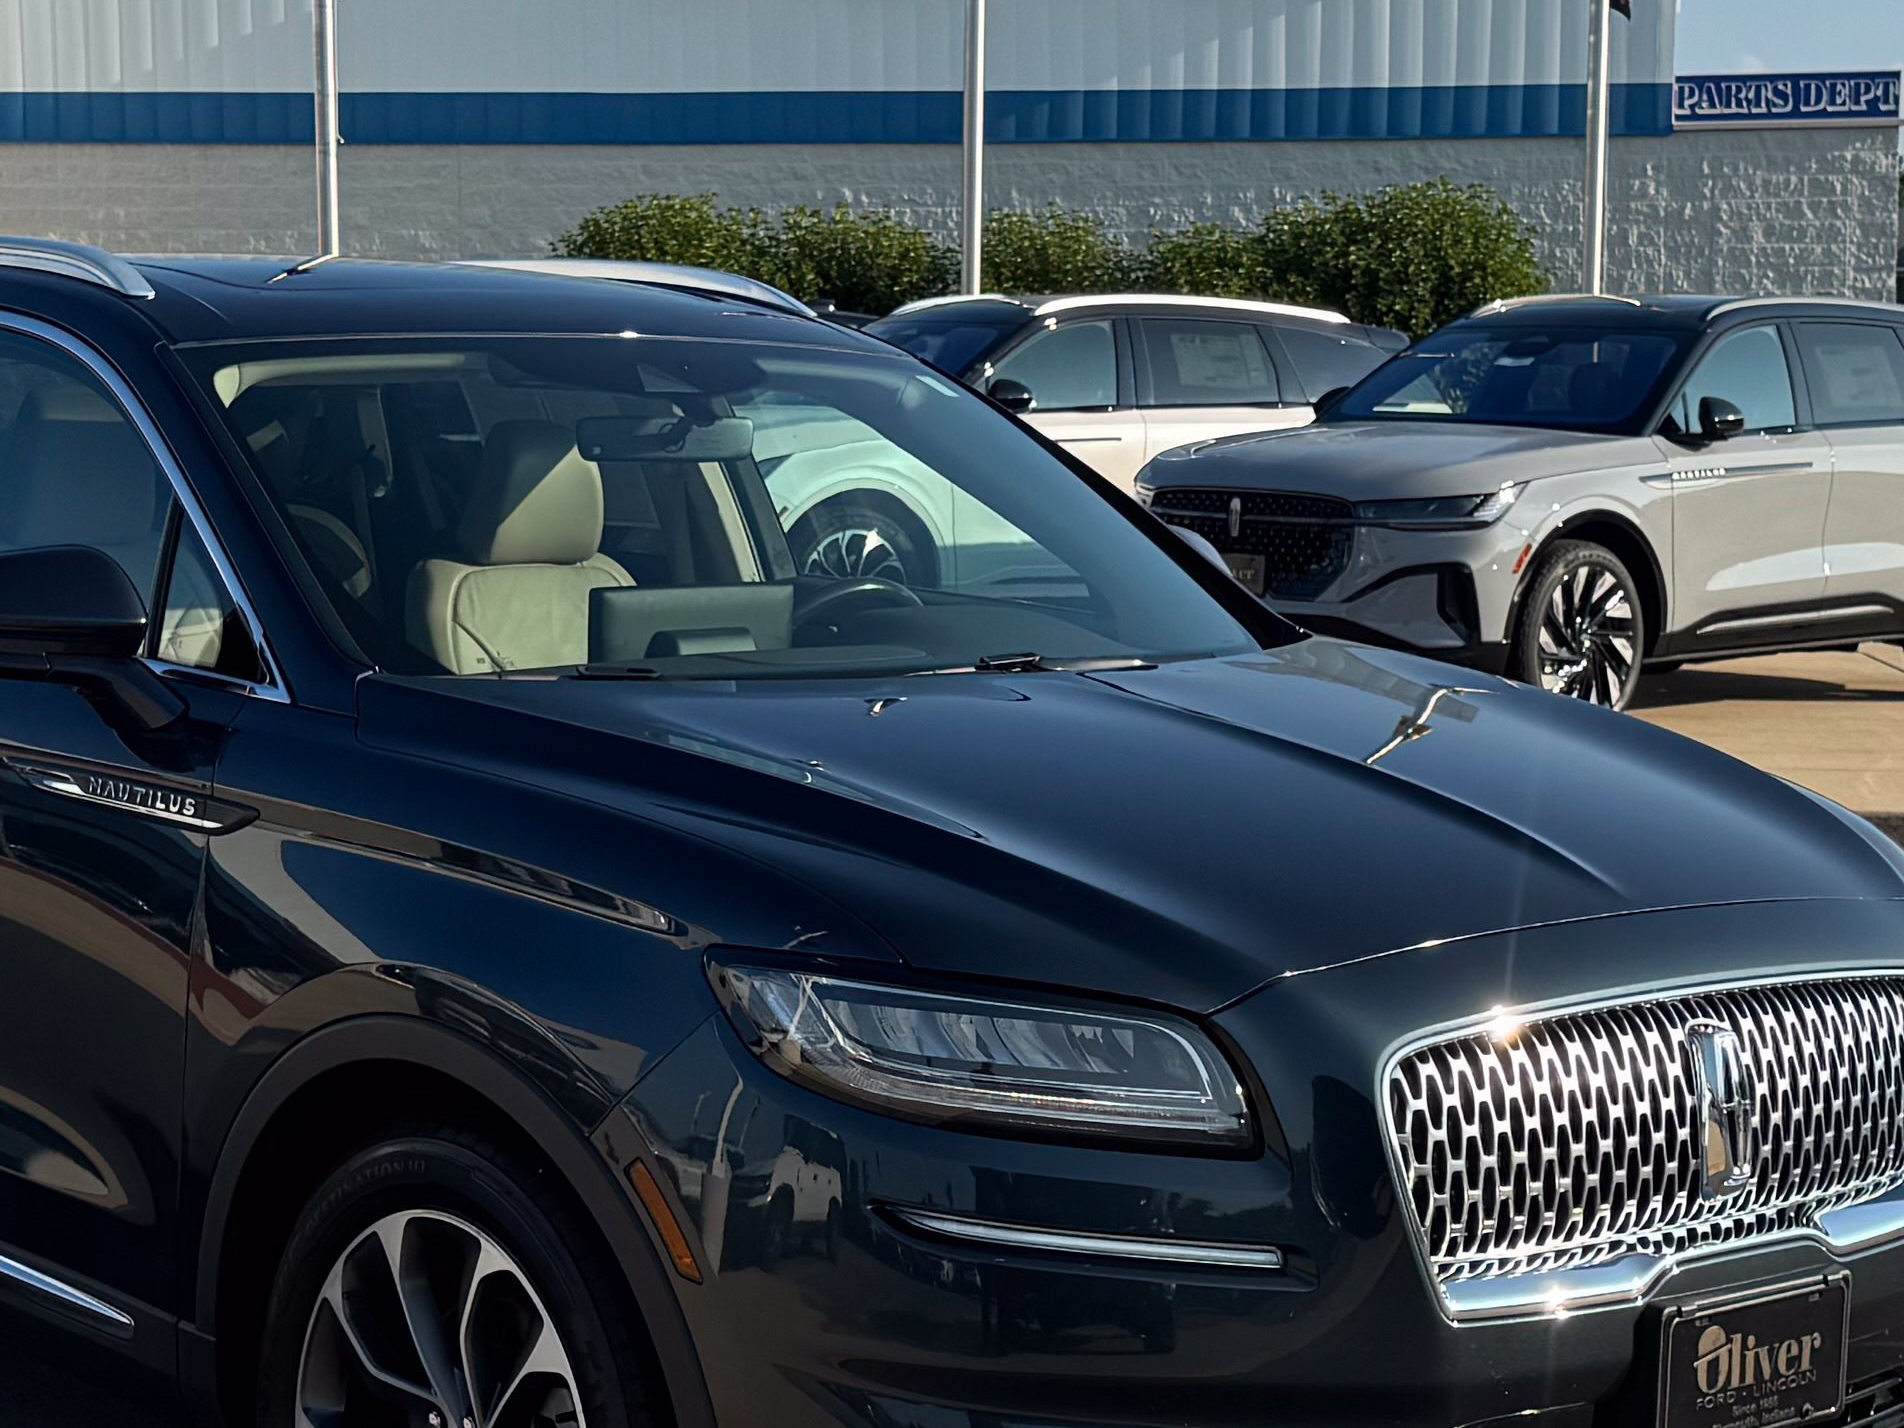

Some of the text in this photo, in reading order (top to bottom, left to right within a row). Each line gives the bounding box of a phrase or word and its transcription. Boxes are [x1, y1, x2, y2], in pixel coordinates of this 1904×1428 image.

[1675, 78, 1899, 115] PARTS DEPT
[88, 776, 196, 816] NAUTILUS
[1693, 1325, 1822, 1394] Oliver
[1696, 1369, 1817, 1410] FORD LINCOLN
